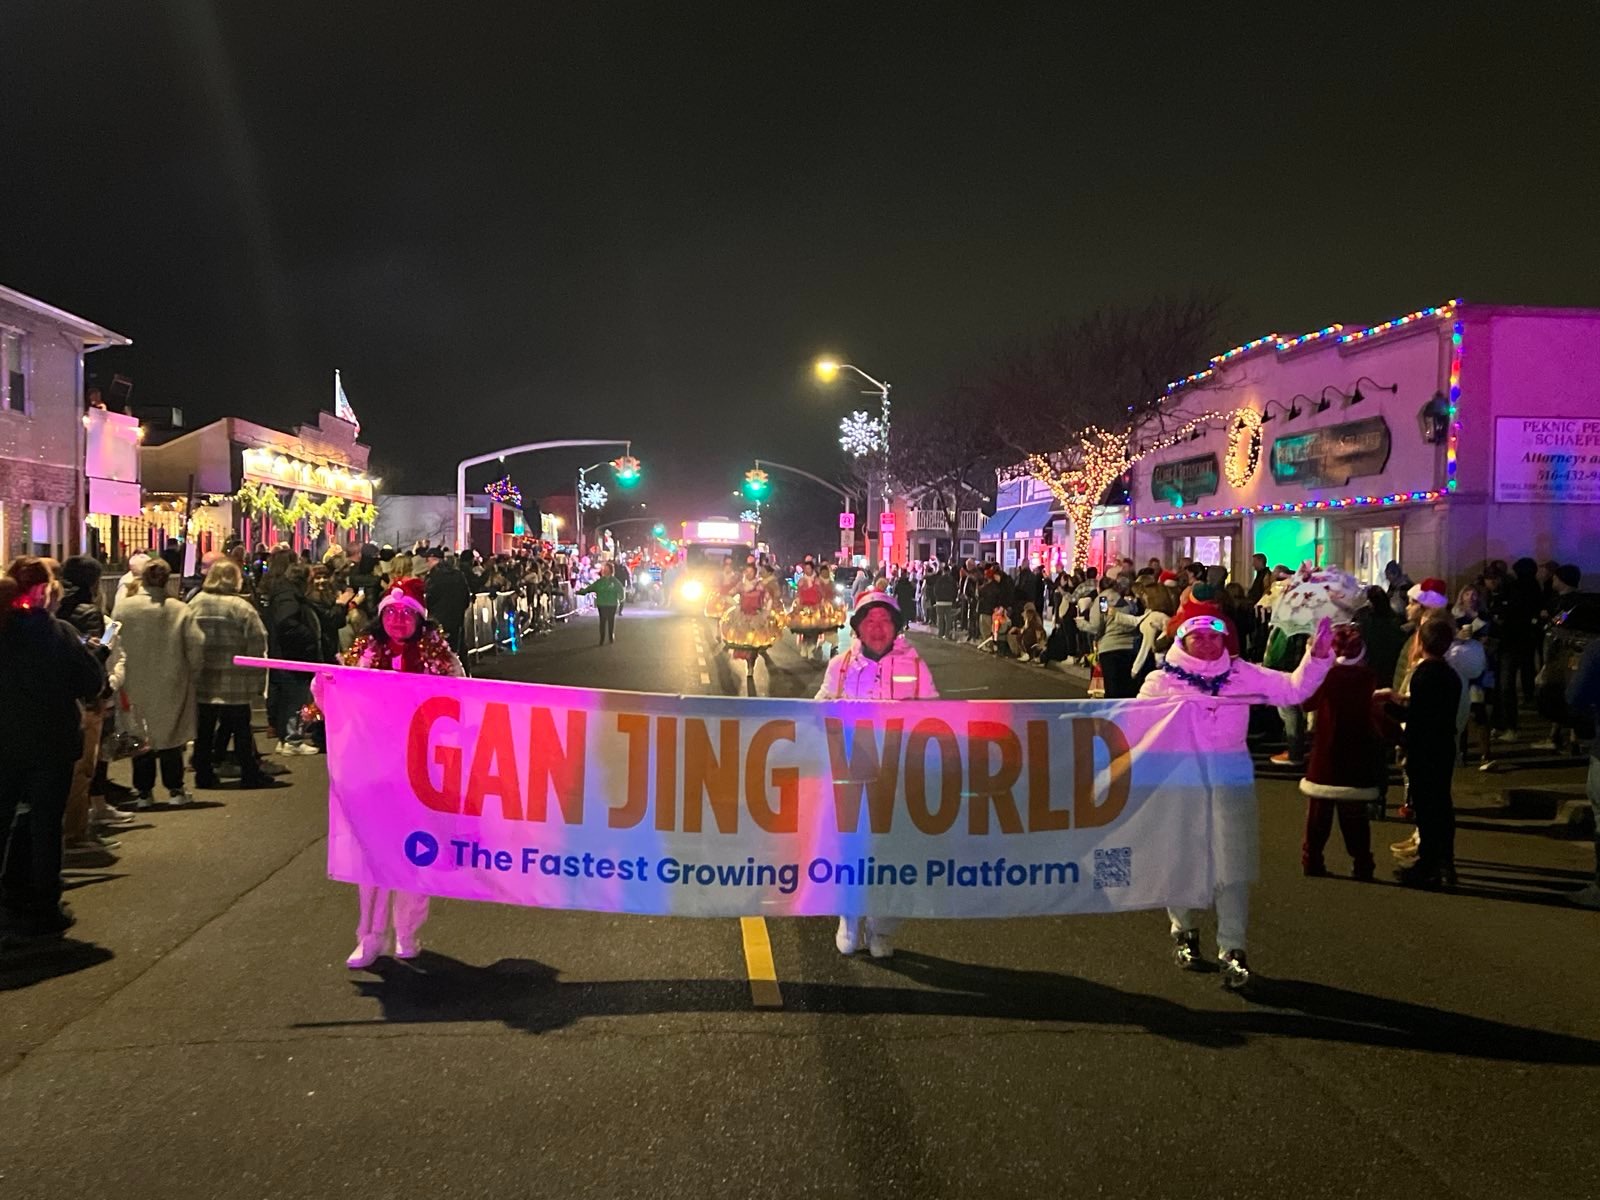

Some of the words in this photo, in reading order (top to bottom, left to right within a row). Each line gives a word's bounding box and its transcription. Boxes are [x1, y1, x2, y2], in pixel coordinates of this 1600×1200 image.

[1523, 421, 1576, 433] PEKNIC
[1521, 451, 1586, 467] Attorneys
[406, 695, 587, 825] GAN
[608, 713, 799, 834] JING
[825, 717, 1133, 835] WORLD
[451, 839, 513, 872] The
[521, 848, 649, 882] Fastest
[656, 856, 799, 894] Growing
[808, 856, 918, 887] Online
[926, 857, 1080, 888] Platform
